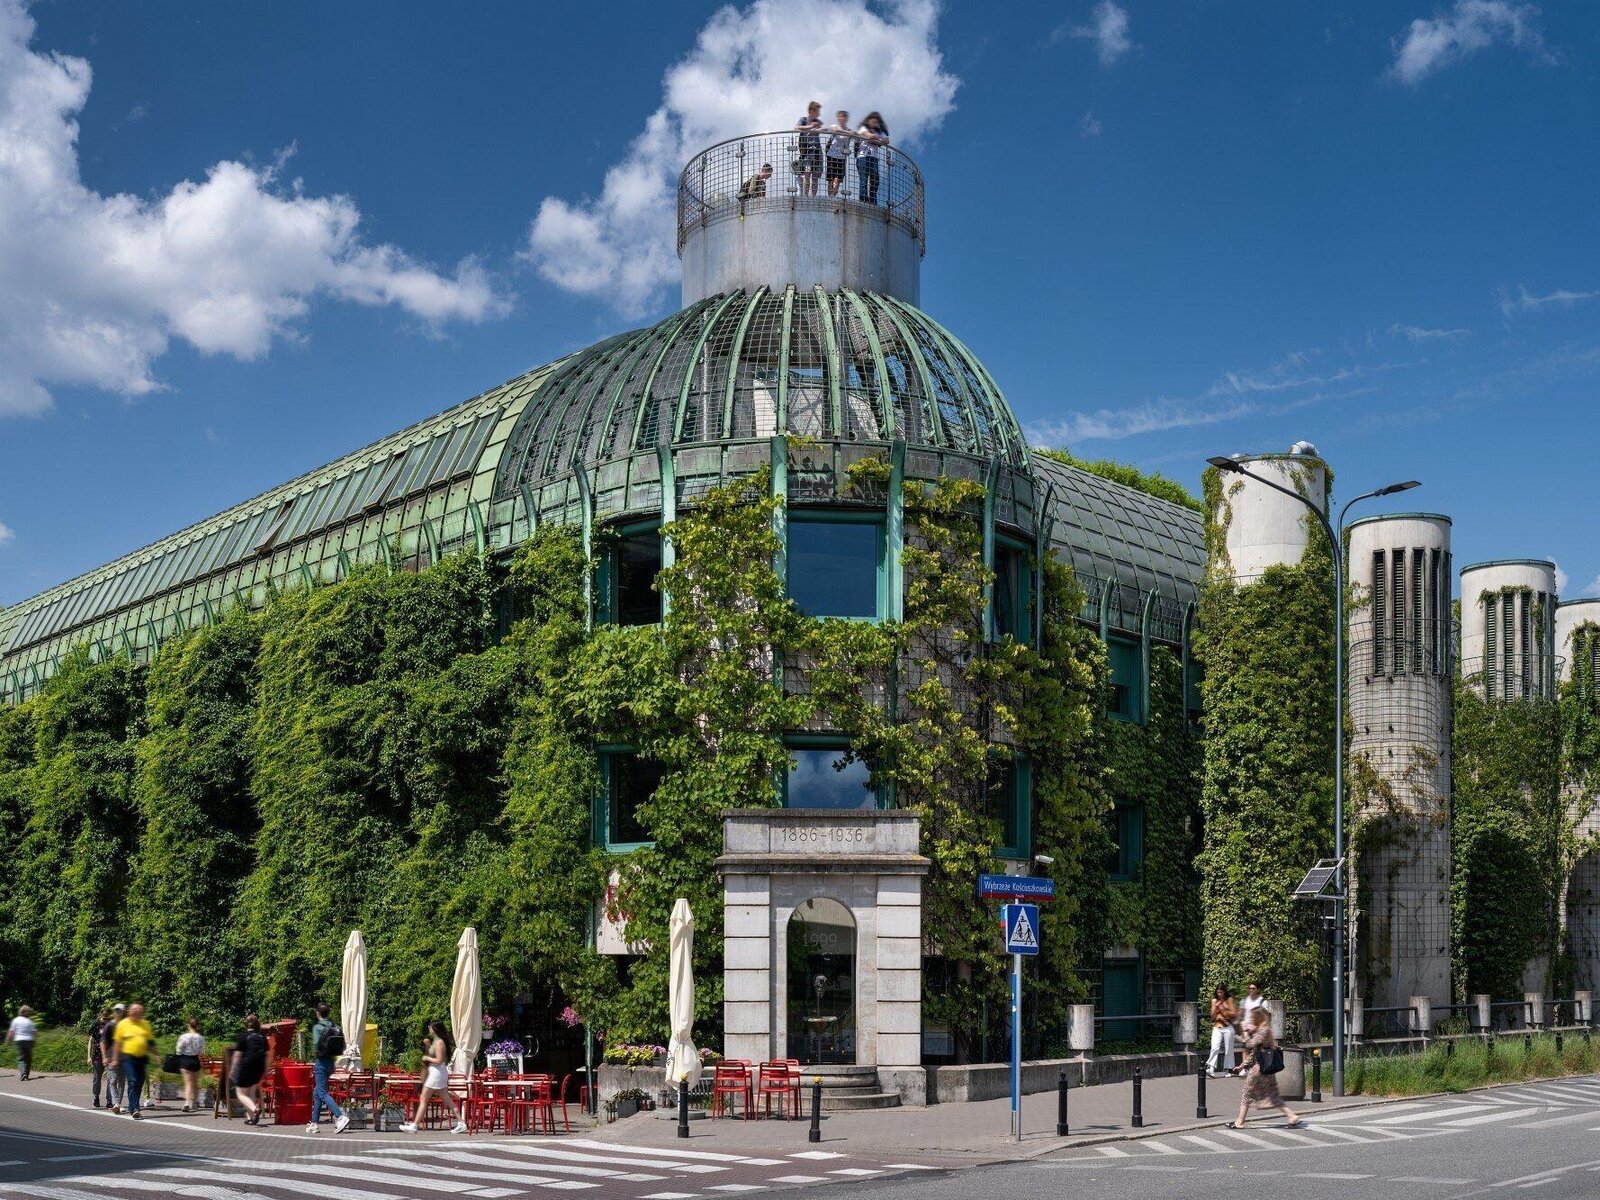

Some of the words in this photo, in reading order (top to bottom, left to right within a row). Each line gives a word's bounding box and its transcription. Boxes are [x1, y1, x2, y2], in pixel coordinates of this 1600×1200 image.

[781, 827, 863, 842] 1886-1936
[984, 881, 1010, 892] Wybrzeże
[802, 933, 838, 946] 1999
